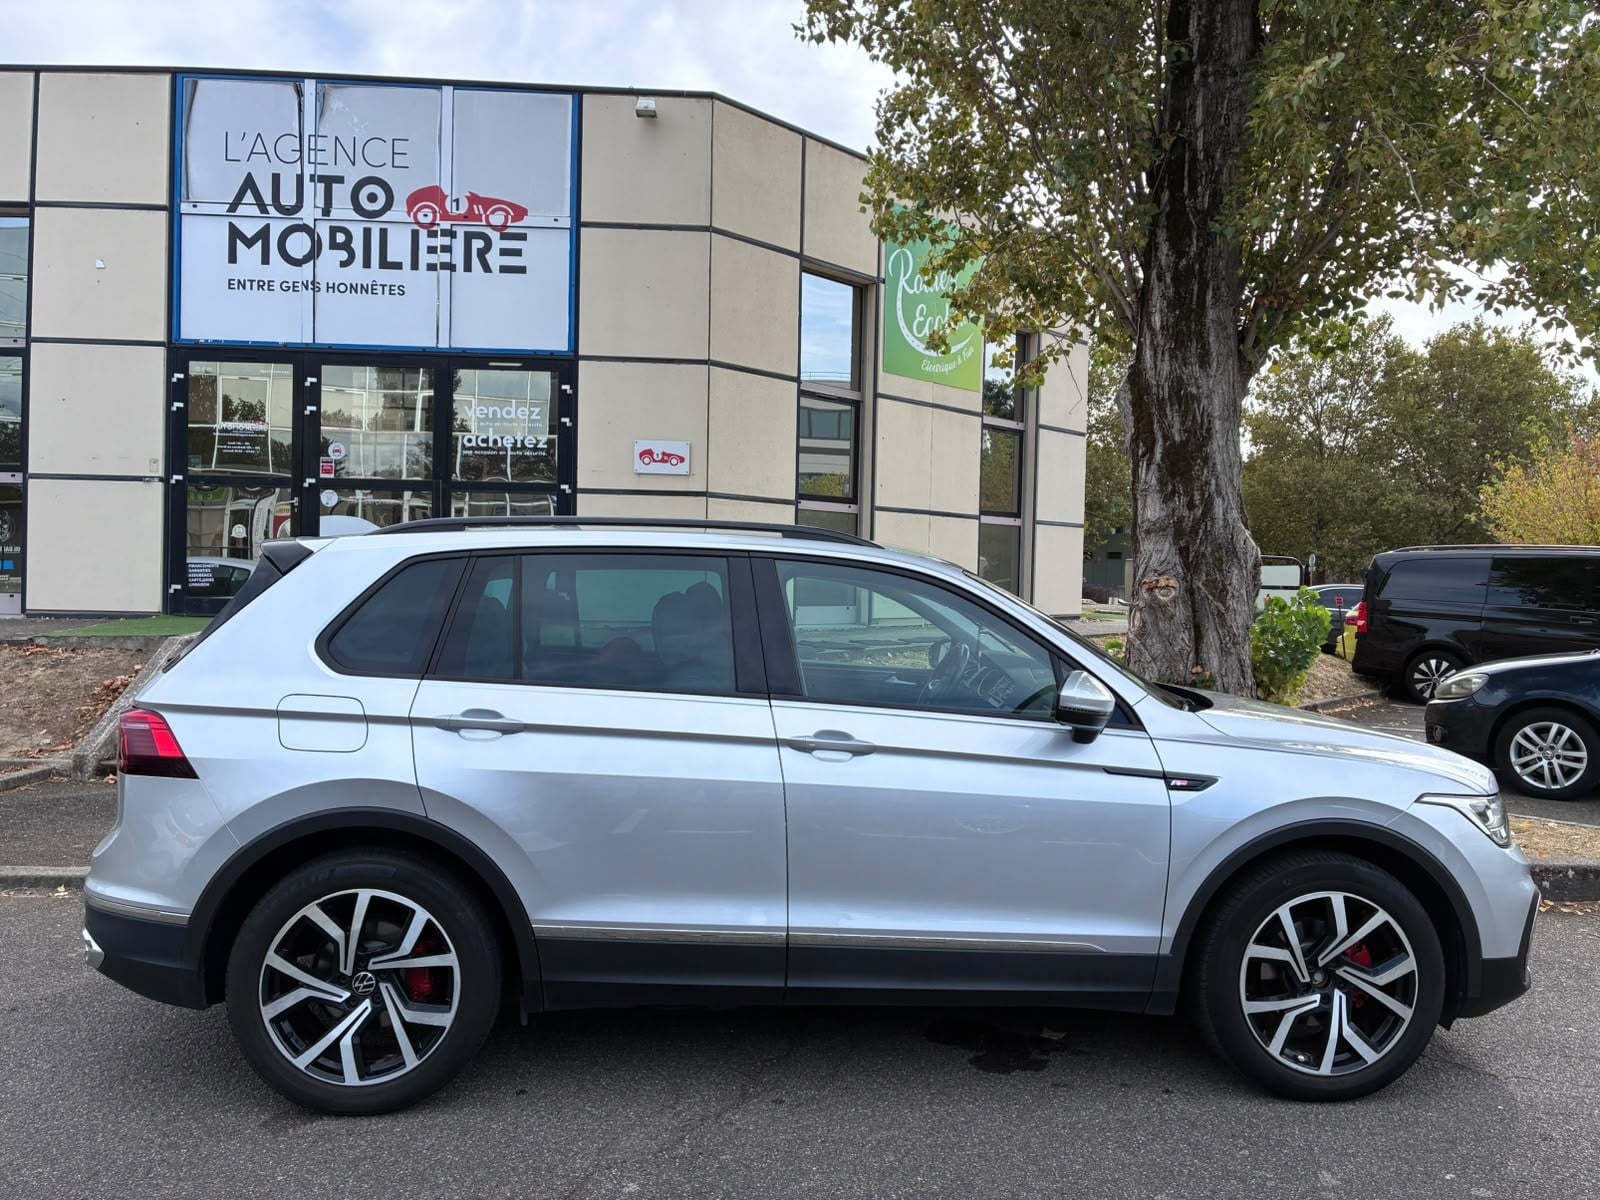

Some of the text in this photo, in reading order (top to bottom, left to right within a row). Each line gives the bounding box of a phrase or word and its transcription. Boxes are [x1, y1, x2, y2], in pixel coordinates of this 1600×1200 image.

[224, 131, 410, 169] L'AGENCE
[226, 171, 395, 219] AUTO
[227, 220, 528, 275] MOBILIERE
[227, 278, 406, 297] ENTRE GENS HONNÊTES
[464, 399, 541, 420] vendez
[463, 427, 548, 449] achetez
